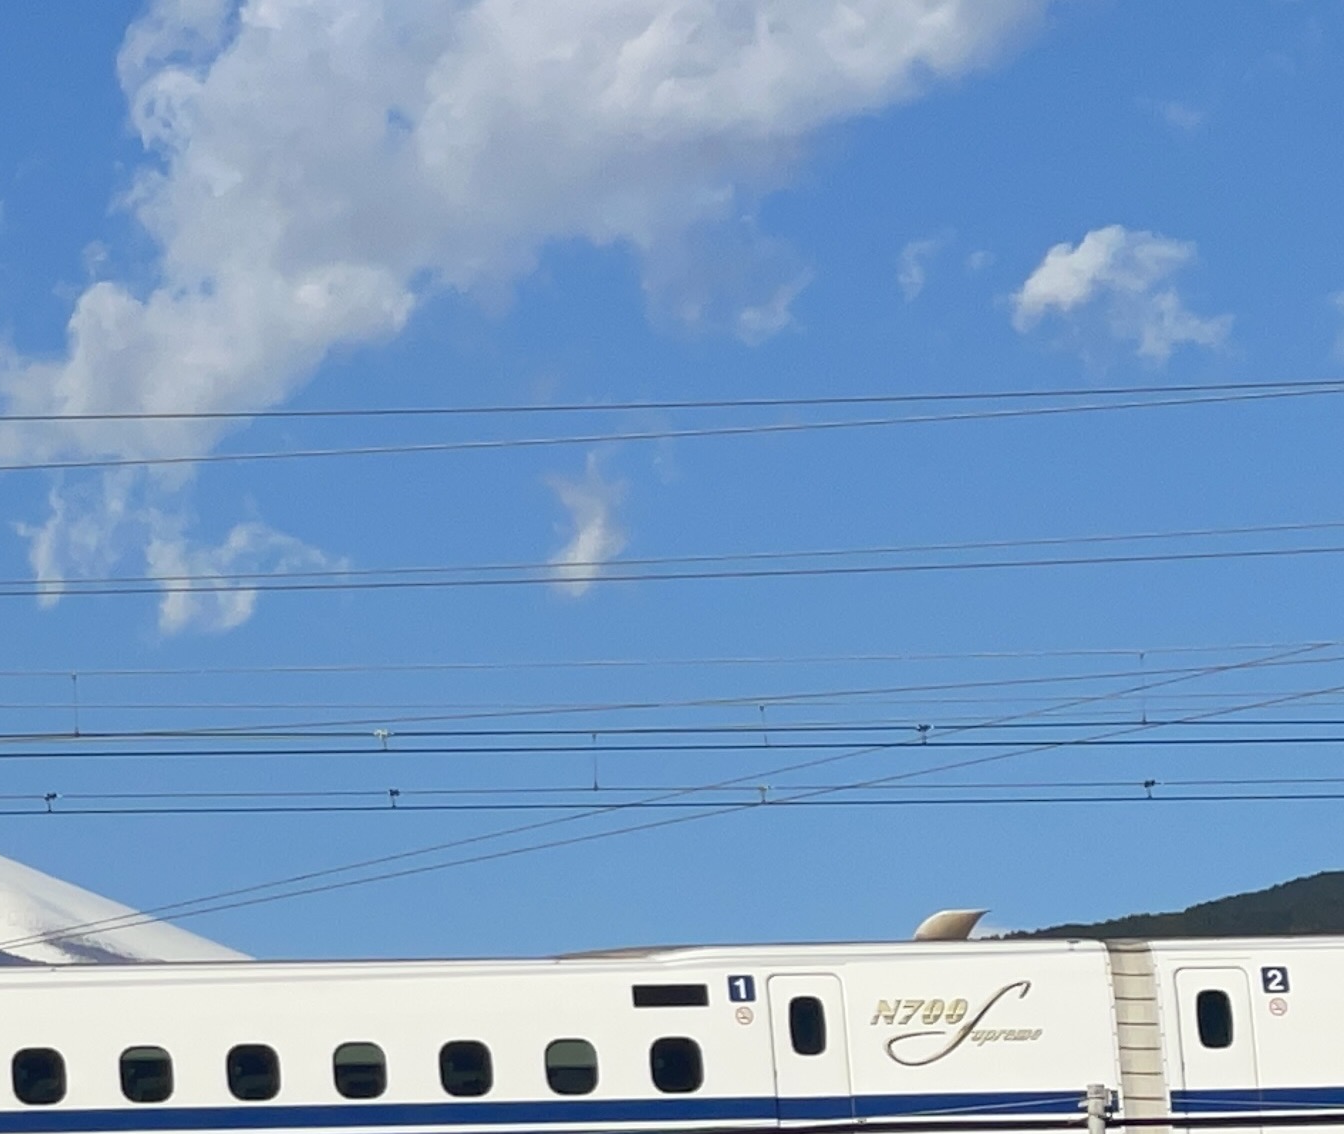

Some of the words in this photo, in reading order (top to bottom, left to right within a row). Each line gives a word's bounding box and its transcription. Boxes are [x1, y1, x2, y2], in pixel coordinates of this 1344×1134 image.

[733, 978, 747, 999] 1
[1267, 969, 1284, 991] 2
[870, 998, 968, 1025] N700
